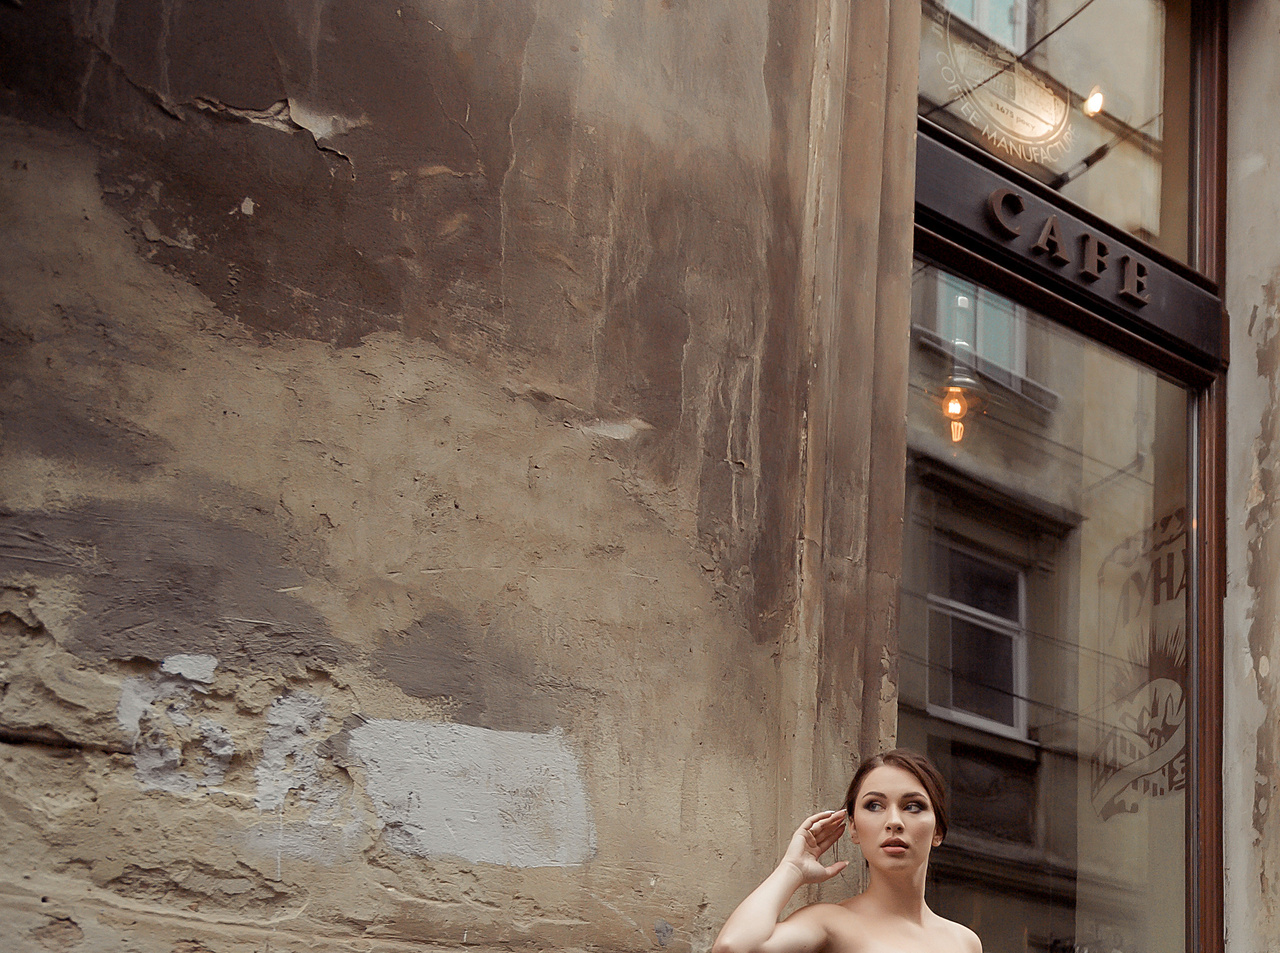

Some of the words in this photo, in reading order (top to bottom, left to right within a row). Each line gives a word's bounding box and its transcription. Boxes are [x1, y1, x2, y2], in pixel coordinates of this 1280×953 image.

[936, 51, 981, 127] COFFEE
[982, 123, 1080, 164] MANUFACTURE
[987, 187, 1151, 307] CAFE
